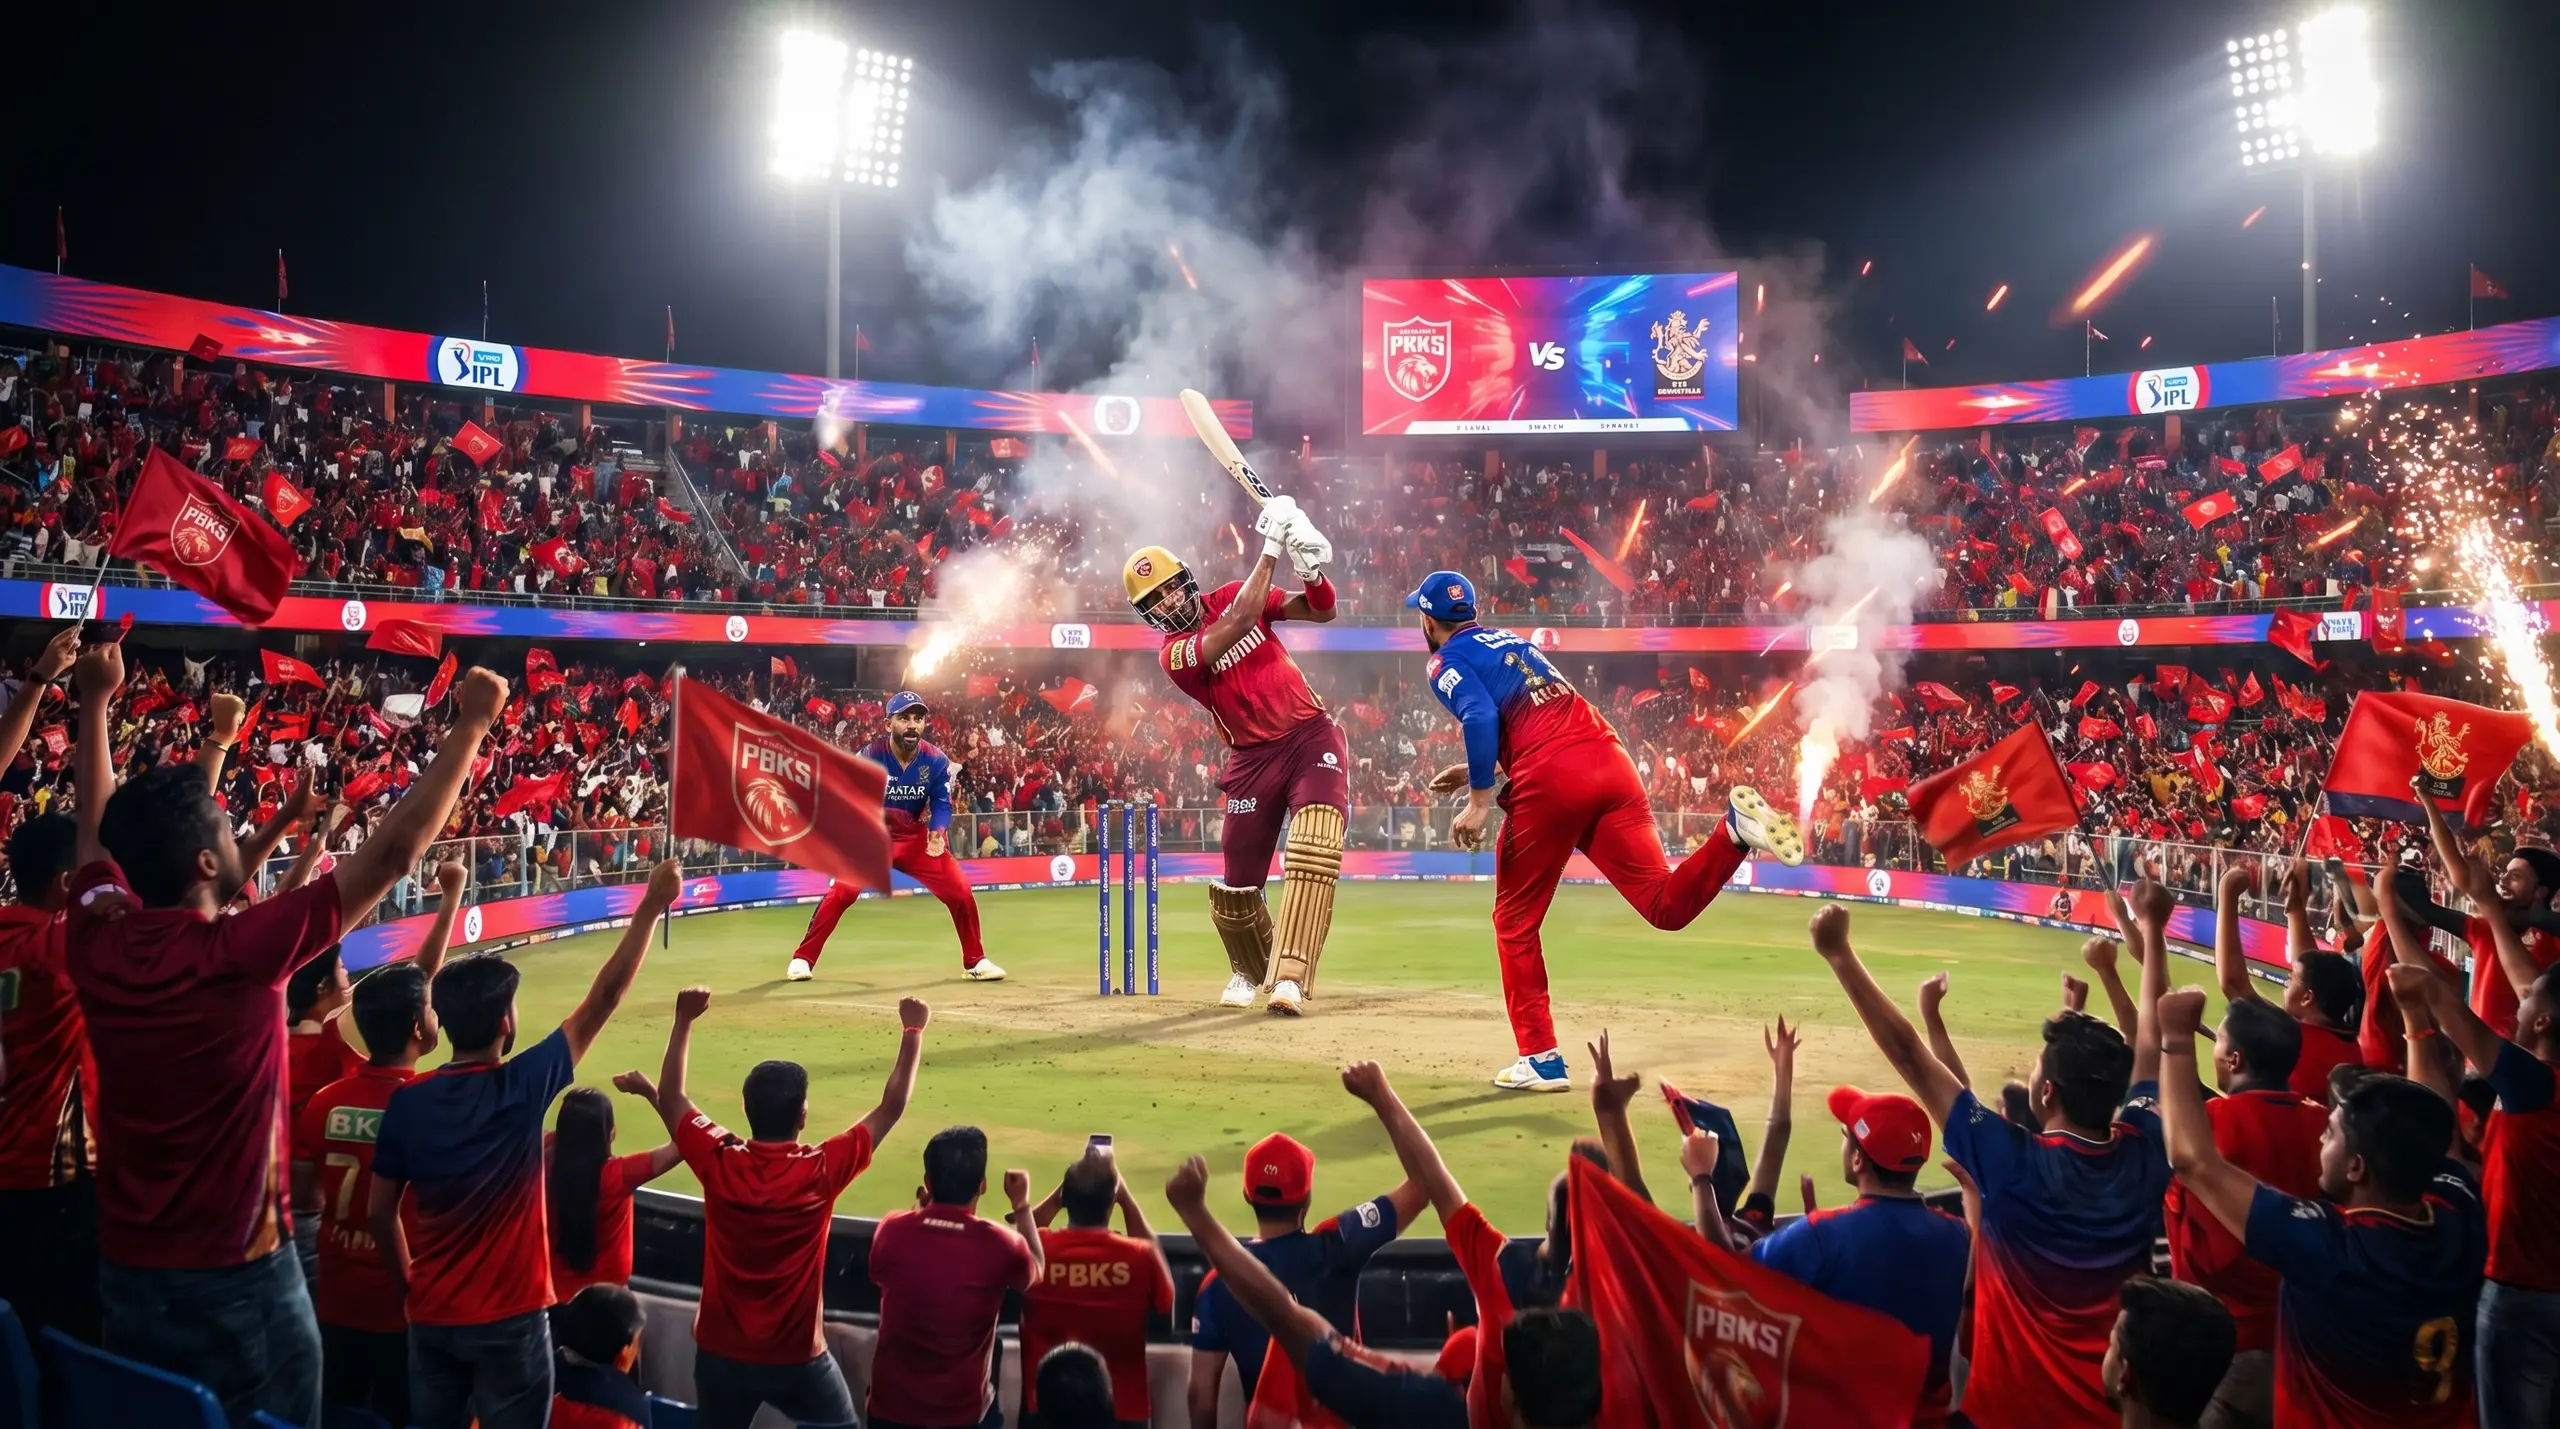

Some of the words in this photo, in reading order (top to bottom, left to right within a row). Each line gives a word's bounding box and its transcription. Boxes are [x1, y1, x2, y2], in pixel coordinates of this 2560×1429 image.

[1528, 341, 1566, 371] VS
[472, 365, 505, 387] IPL
[2164, 389, 2191, 406] IPL
[182, 506, 229, 542] PBKS
[741, 742, 811, 791] PBKS
[325, 1152, 361, 1221] 7
[1050, 1261, 1131, 1288] PBKS
[1695, 1302, 1783, 1359] PBKS
